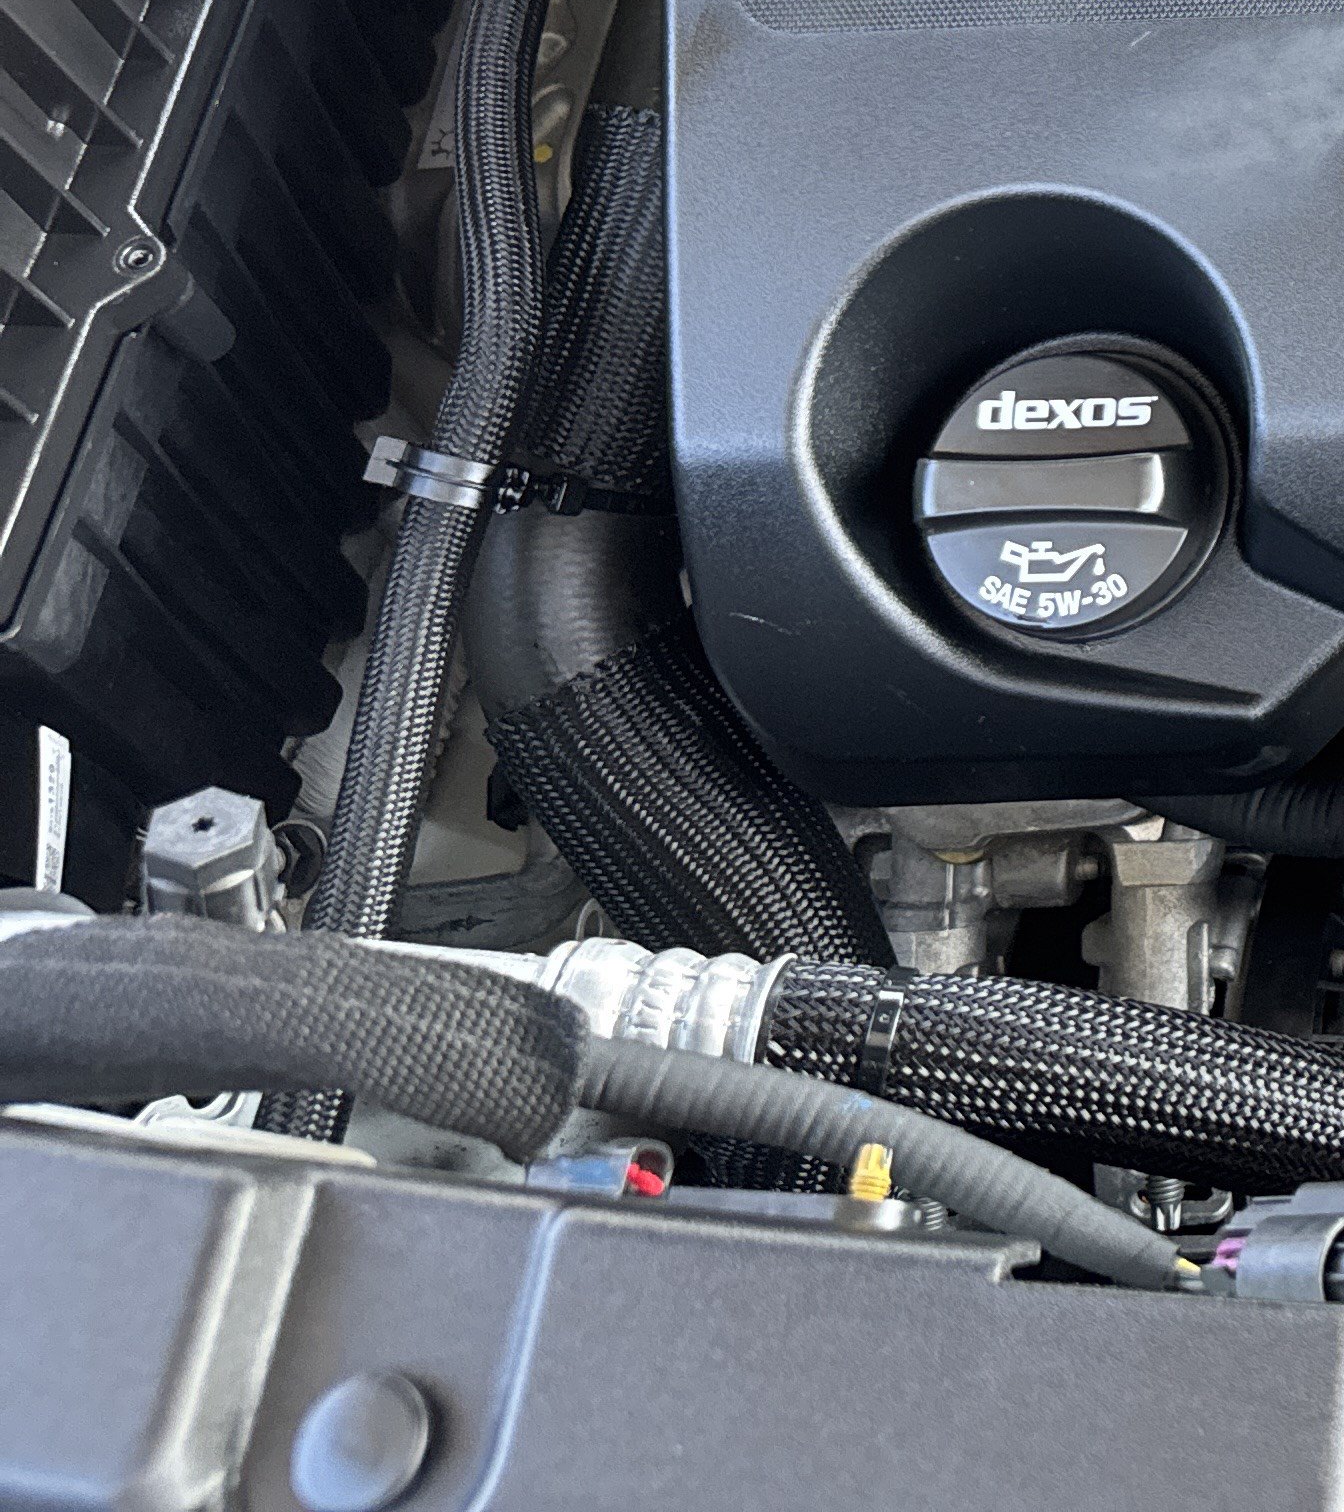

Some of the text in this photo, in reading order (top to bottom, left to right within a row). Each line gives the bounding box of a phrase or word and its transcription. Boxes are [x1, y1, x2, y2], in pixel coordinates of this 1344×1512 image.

[977, 391, 1156, 431] dexos
[978, 573, 1129, 617] SAE 5W-30
